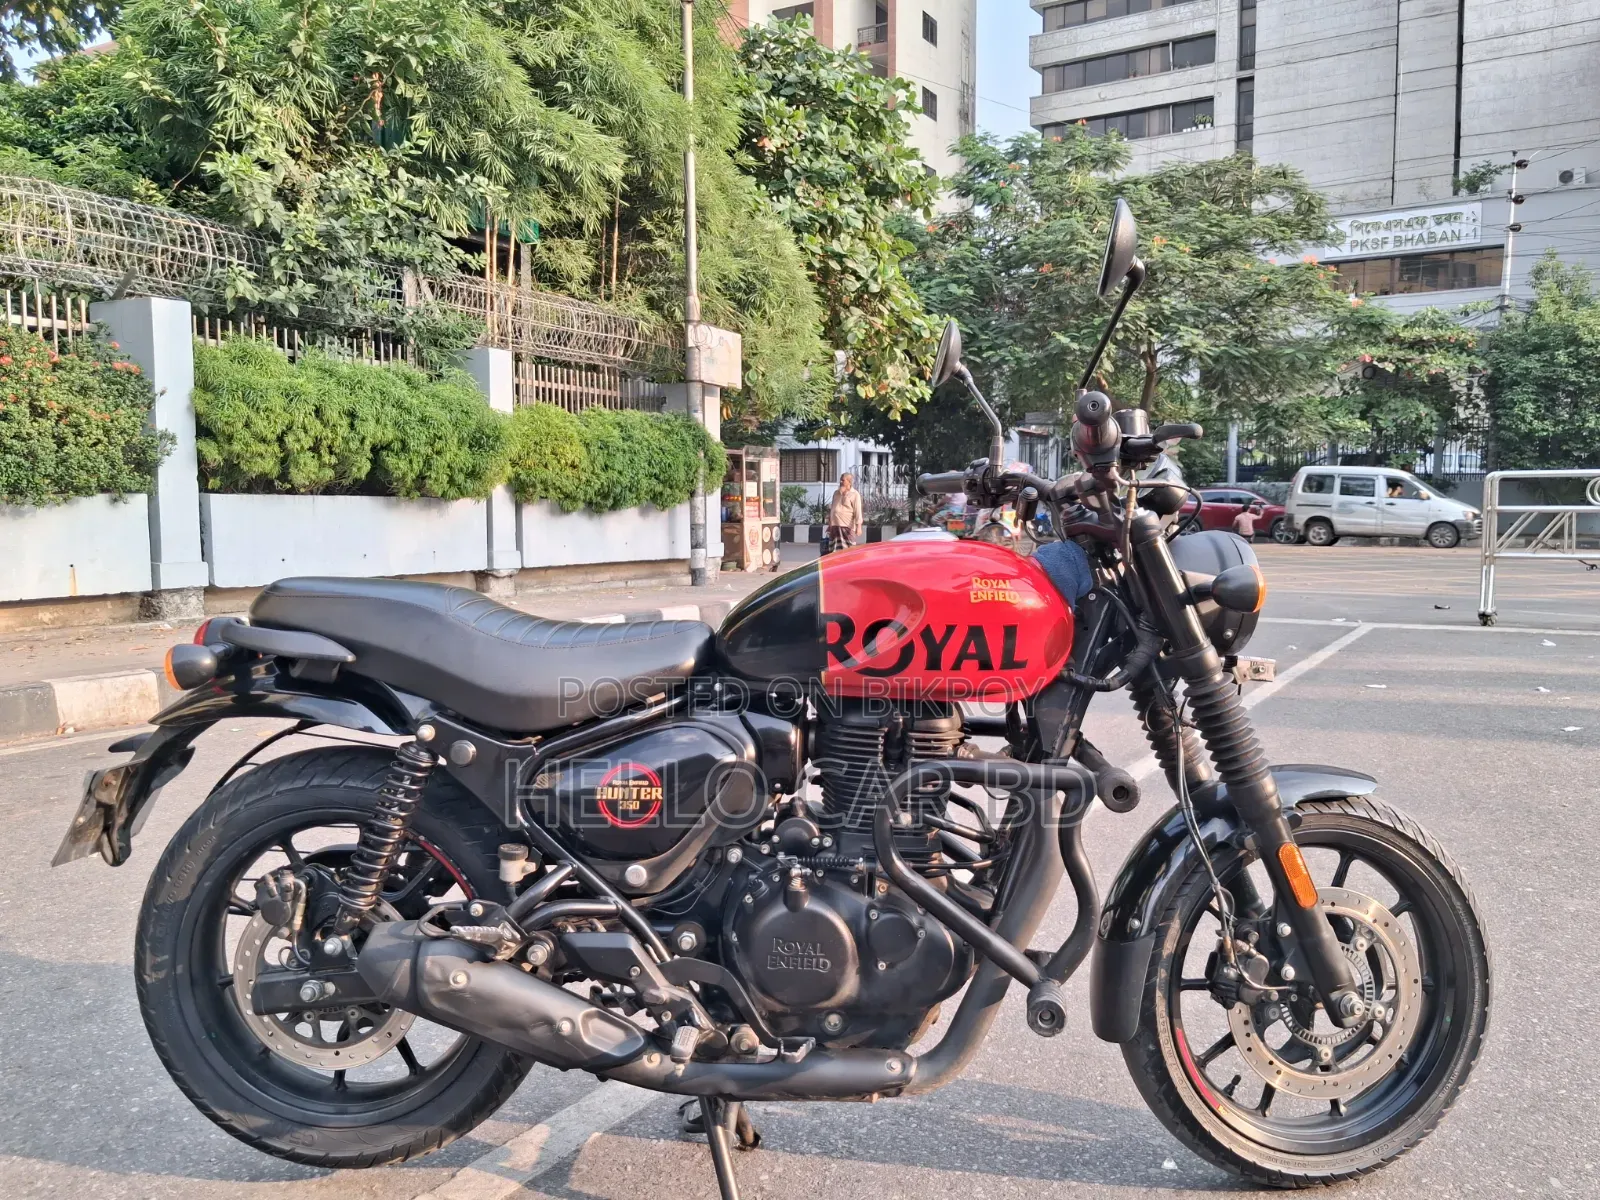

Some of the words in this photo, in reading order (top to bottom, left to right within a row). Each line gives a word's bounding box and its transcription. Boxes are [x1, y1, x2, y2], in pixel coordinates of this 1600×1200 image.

[1431, 212, 1464, 226] ভবন
[1350, 237, 1389, 252] PKSF
[1394, 229, 1461, 248] BHABAN
[972, 577, 1013, 590] ROYAL
[970, 590, 1020, 605] ENFIELD
[820, 612, 1028, 678] ROYAL
[596, 787, 663, 800] HUNTER
[620, 801, 640, 810] 350
[772, 937, 826, 956] ROYAL
[767, 955, 832, 973] ENFIELD
